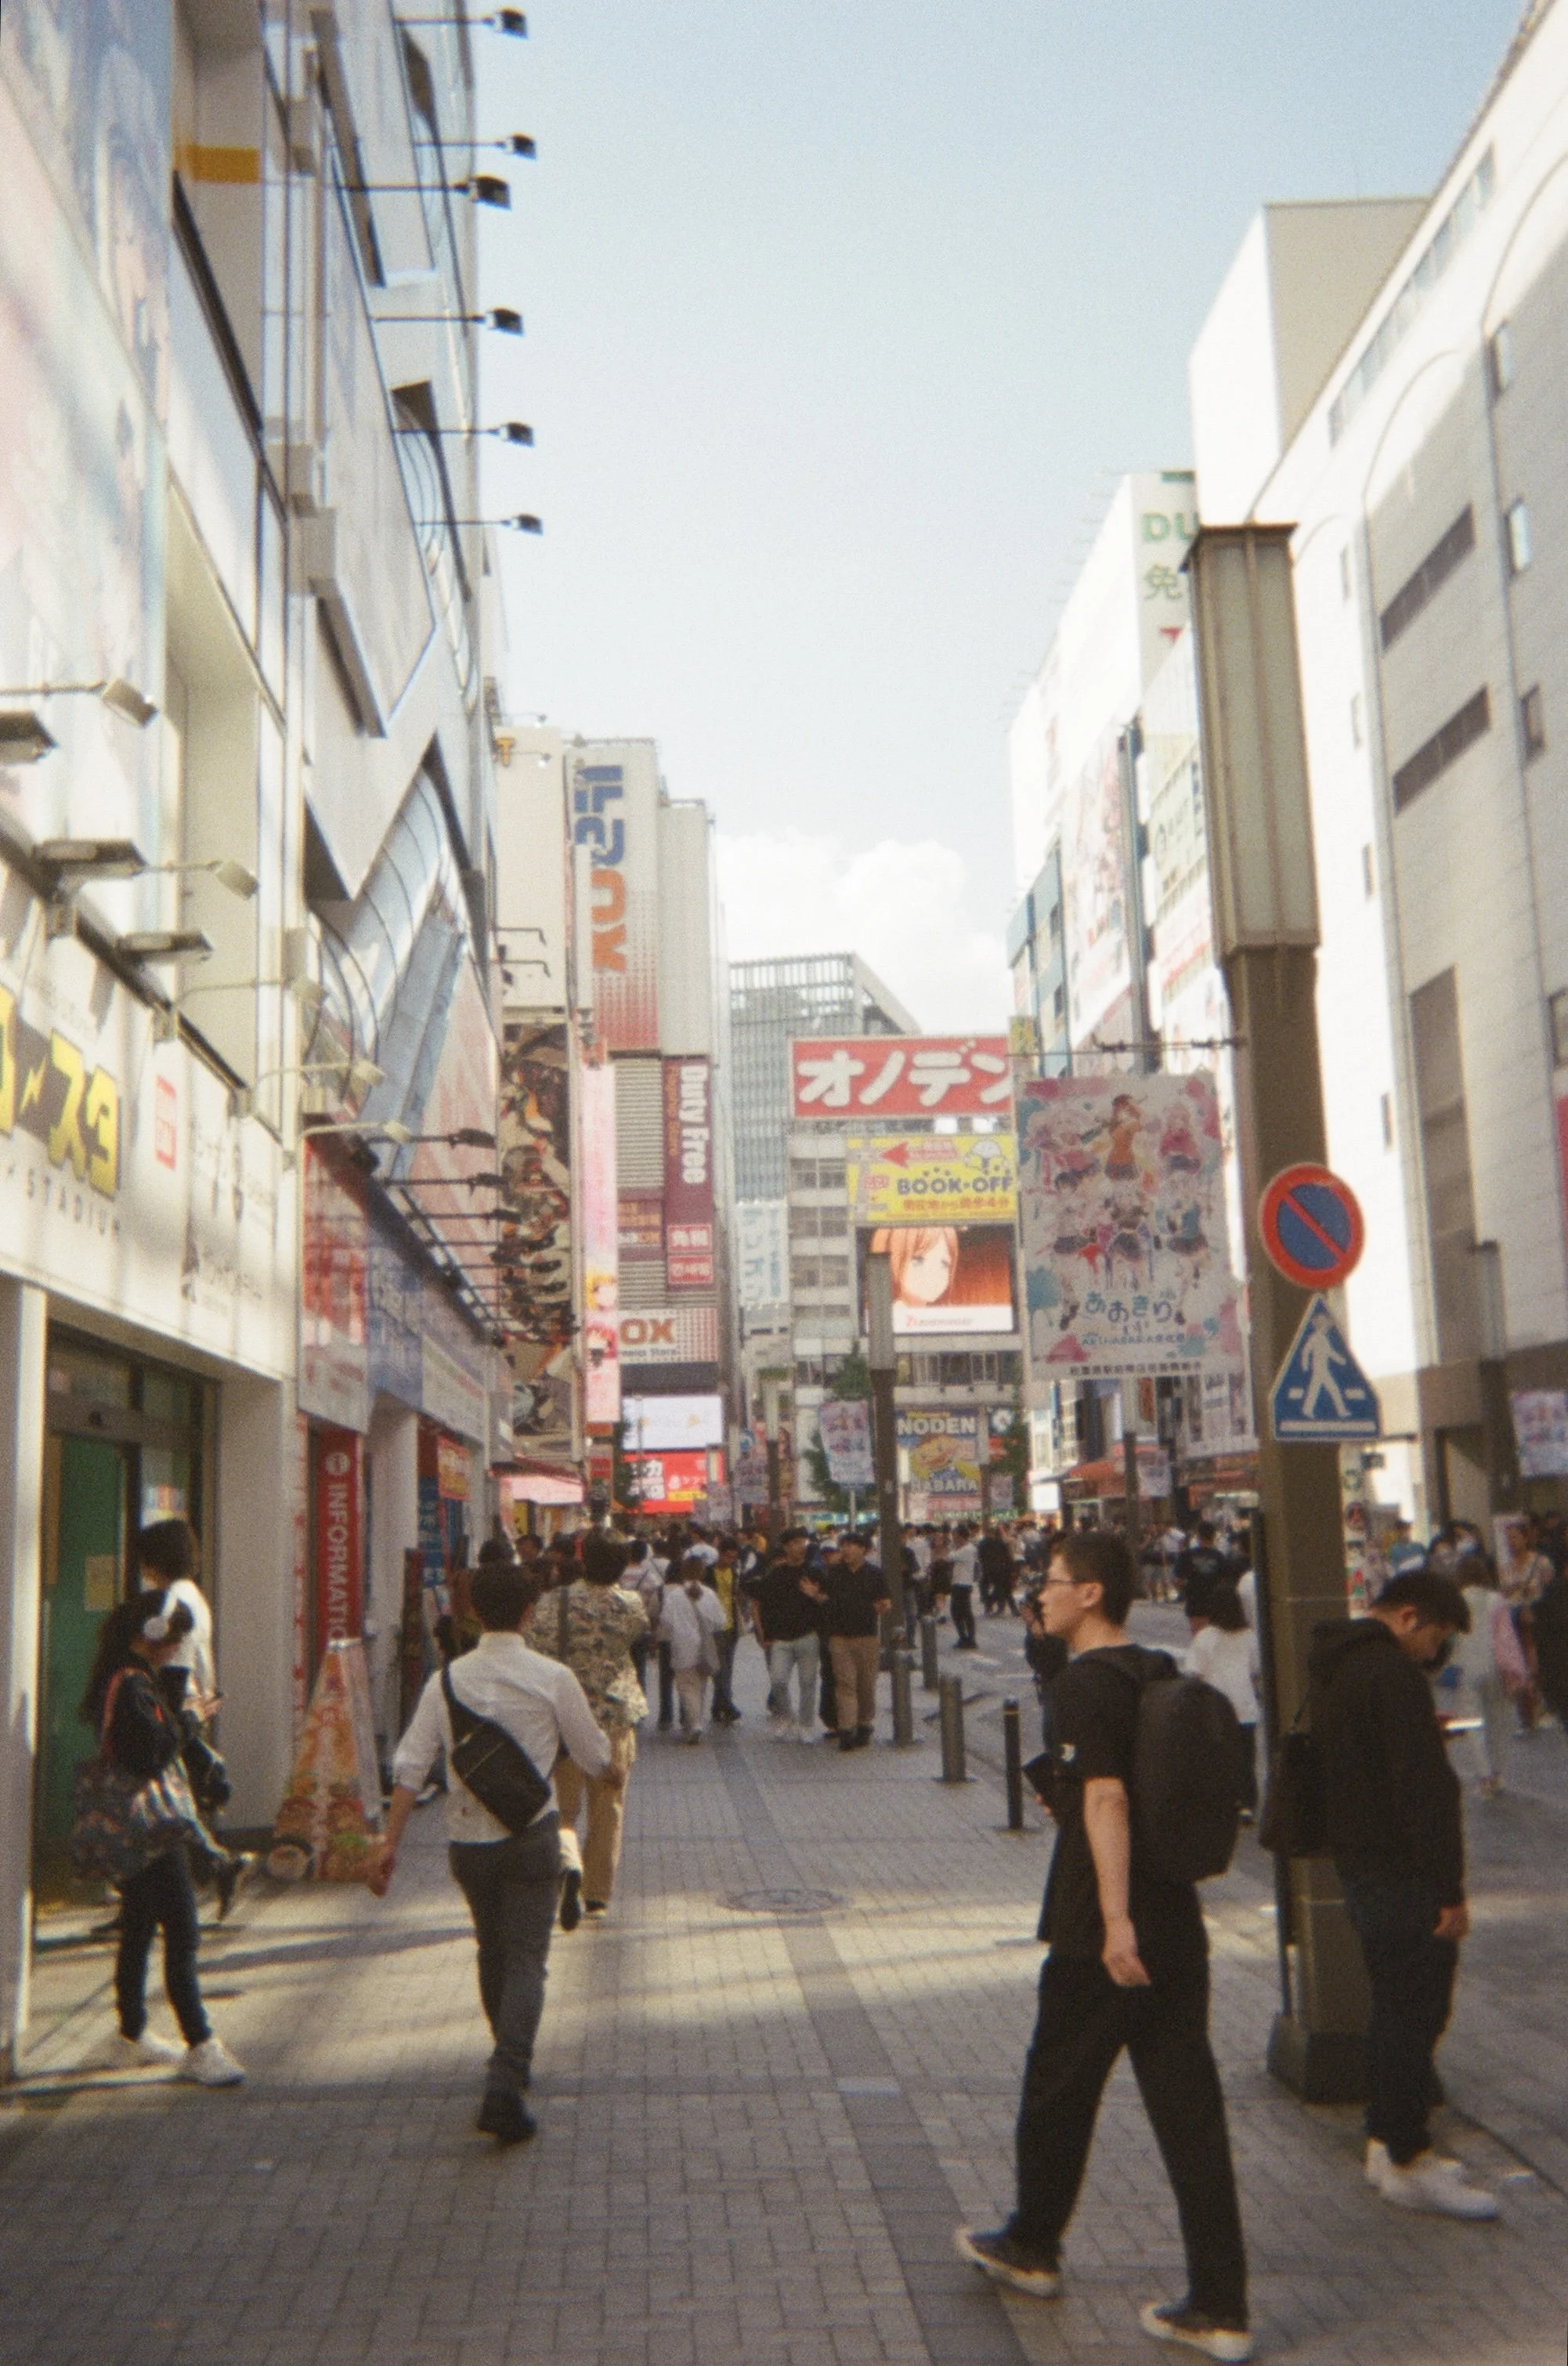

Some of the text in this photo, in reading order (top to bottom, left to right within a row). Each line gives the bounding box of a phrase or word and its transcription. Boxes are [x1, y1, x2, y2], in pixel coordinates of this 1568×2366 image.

[1142, 512, 1199, 542] DU
[1143, 562, 1185, 601] 免
[679, 1064, 710, 1184] Duty Free
[619, 1317, 675, 1346] OX
[896, 1416, 977, 1436] NODEN
[327, 1483, 349, 1639] INFORMATIO
